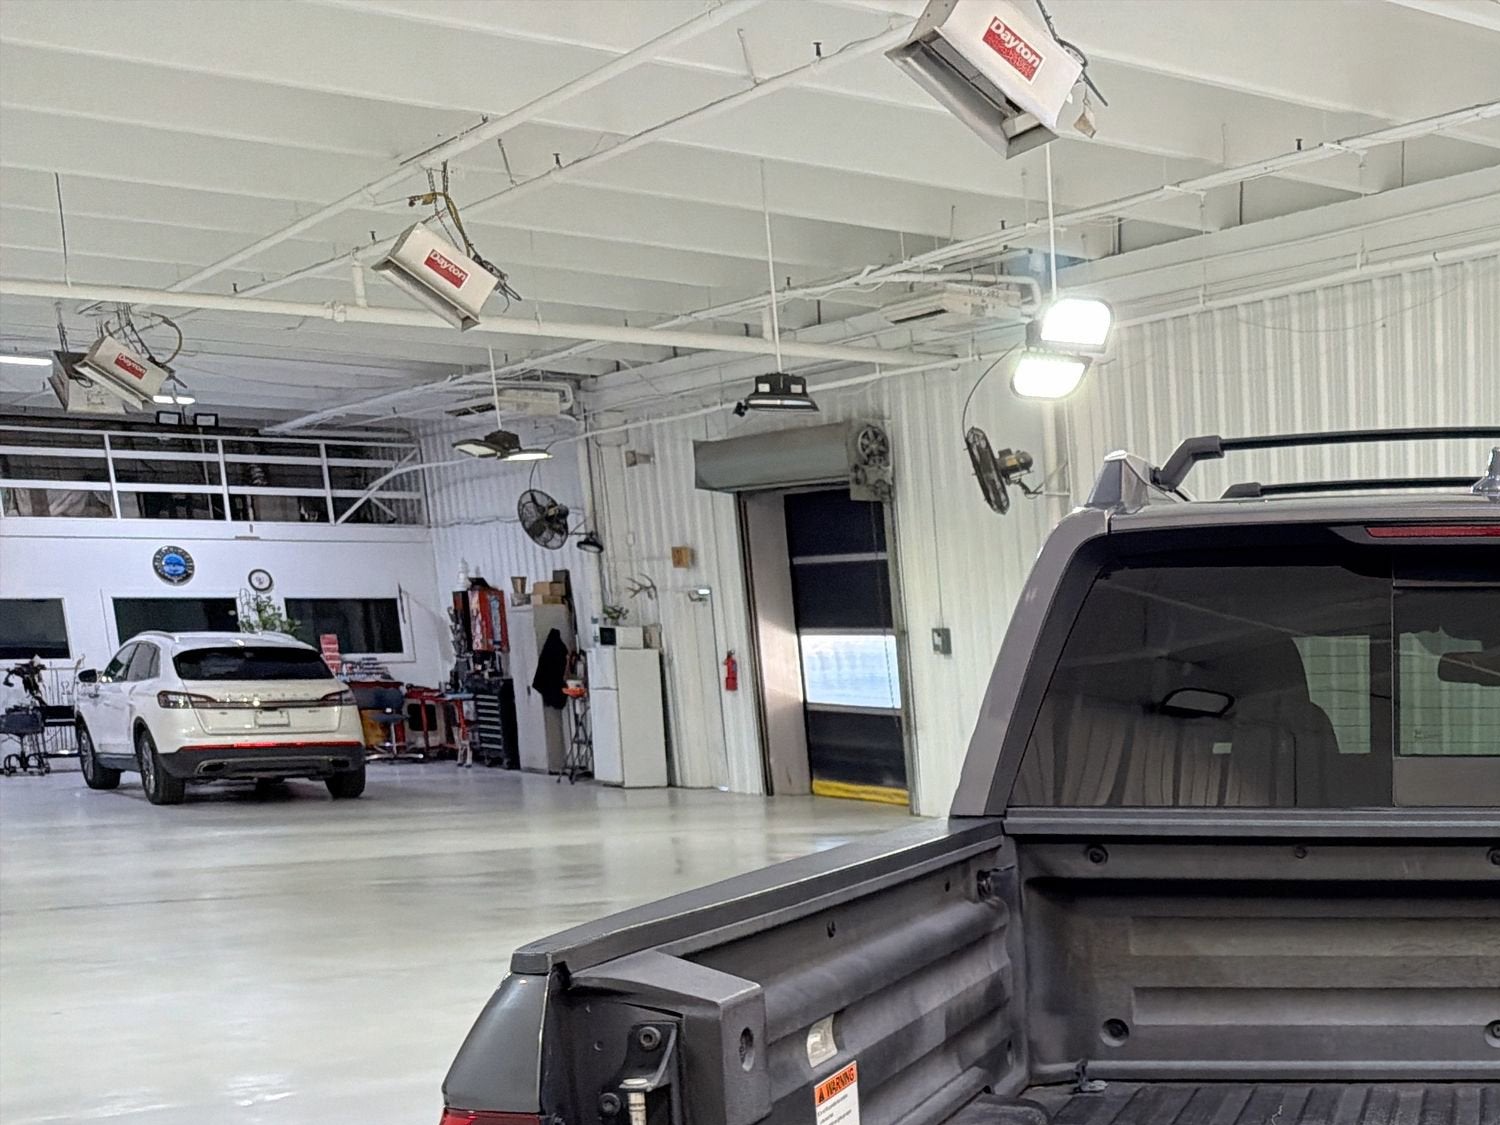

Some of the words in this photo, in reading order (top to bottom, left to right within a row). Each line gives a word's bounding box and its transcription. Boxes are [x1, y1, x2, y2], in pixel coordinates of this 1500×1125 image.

[990, 20, 1040, 68] Dayton
[430, 251, 466, 281] Dayton
[826, 1067, 855, 1096] WARNING
